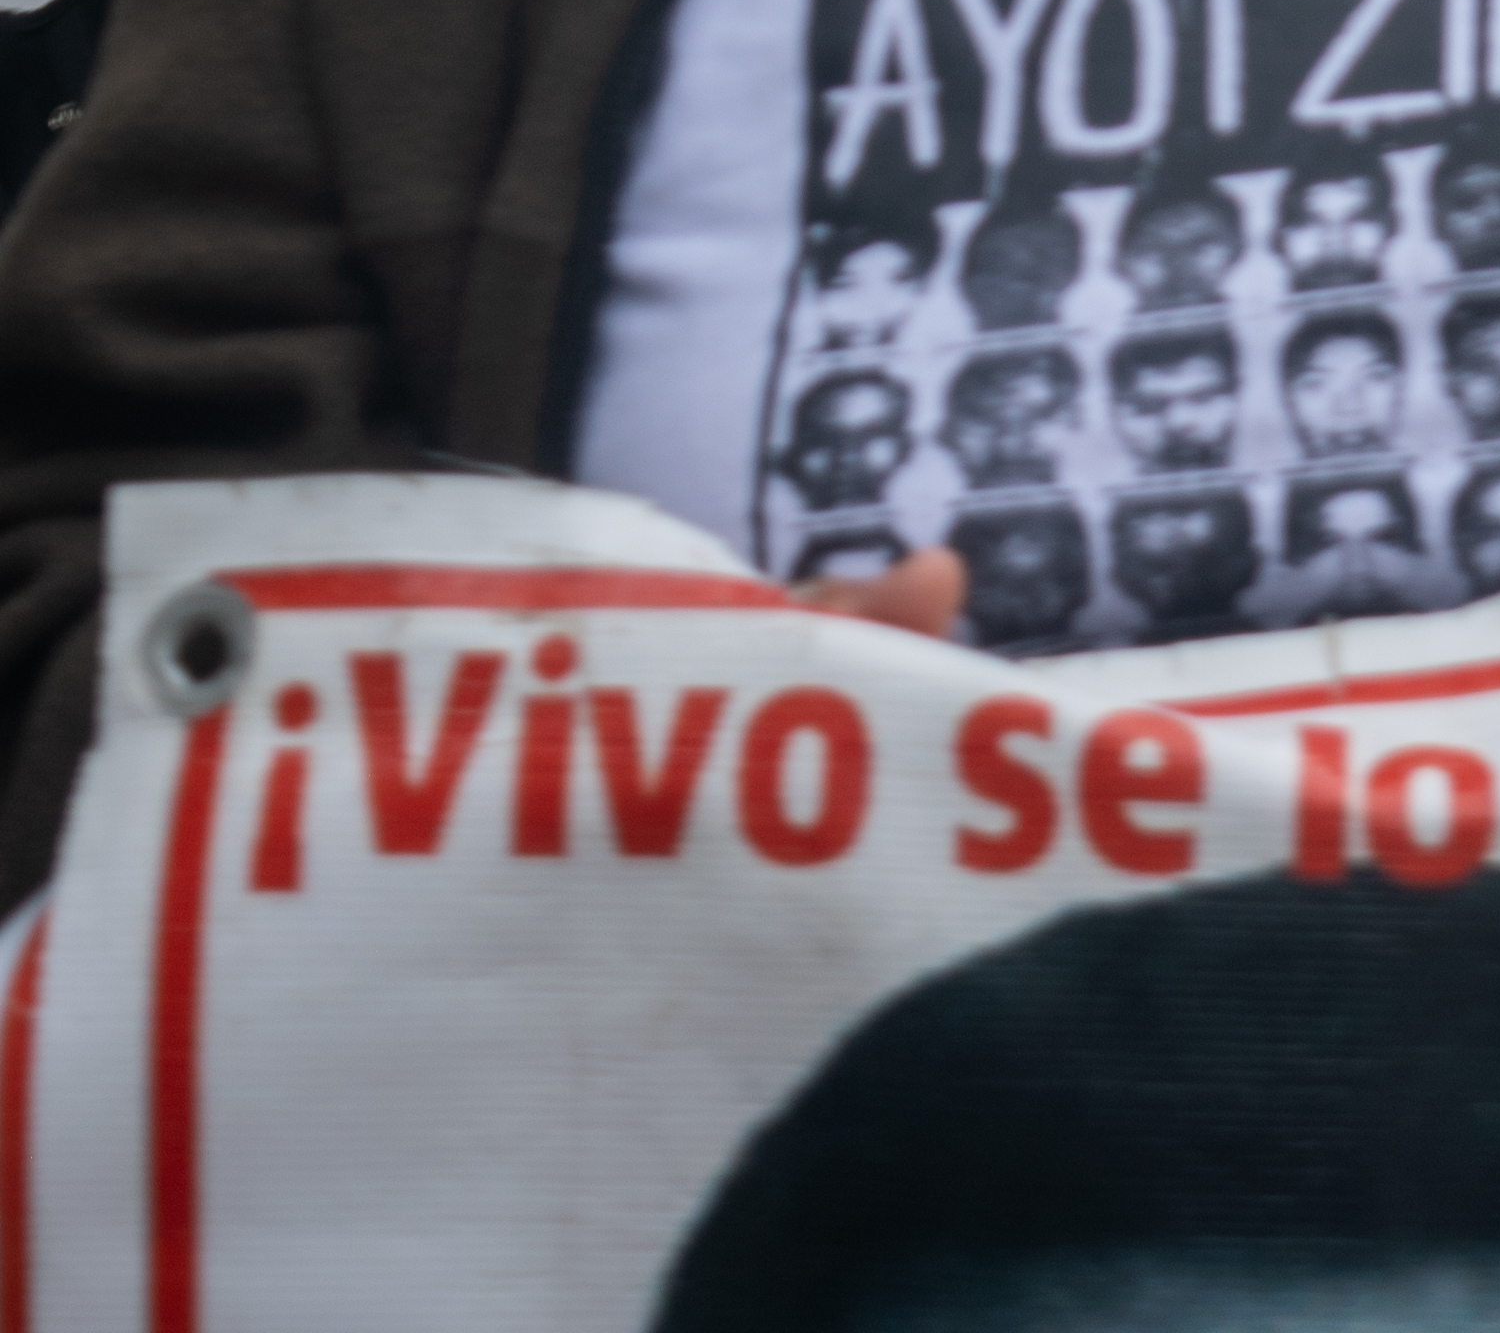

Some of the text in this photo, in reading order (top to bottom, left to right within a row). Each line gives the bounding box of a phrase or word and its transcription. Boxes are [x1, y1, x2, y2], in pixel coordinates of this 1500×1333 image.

[247, 631, 874, 895] ¡Vivo
[949, 692, 1207, 879] se
[1288, 719, 1498, 889] lo
